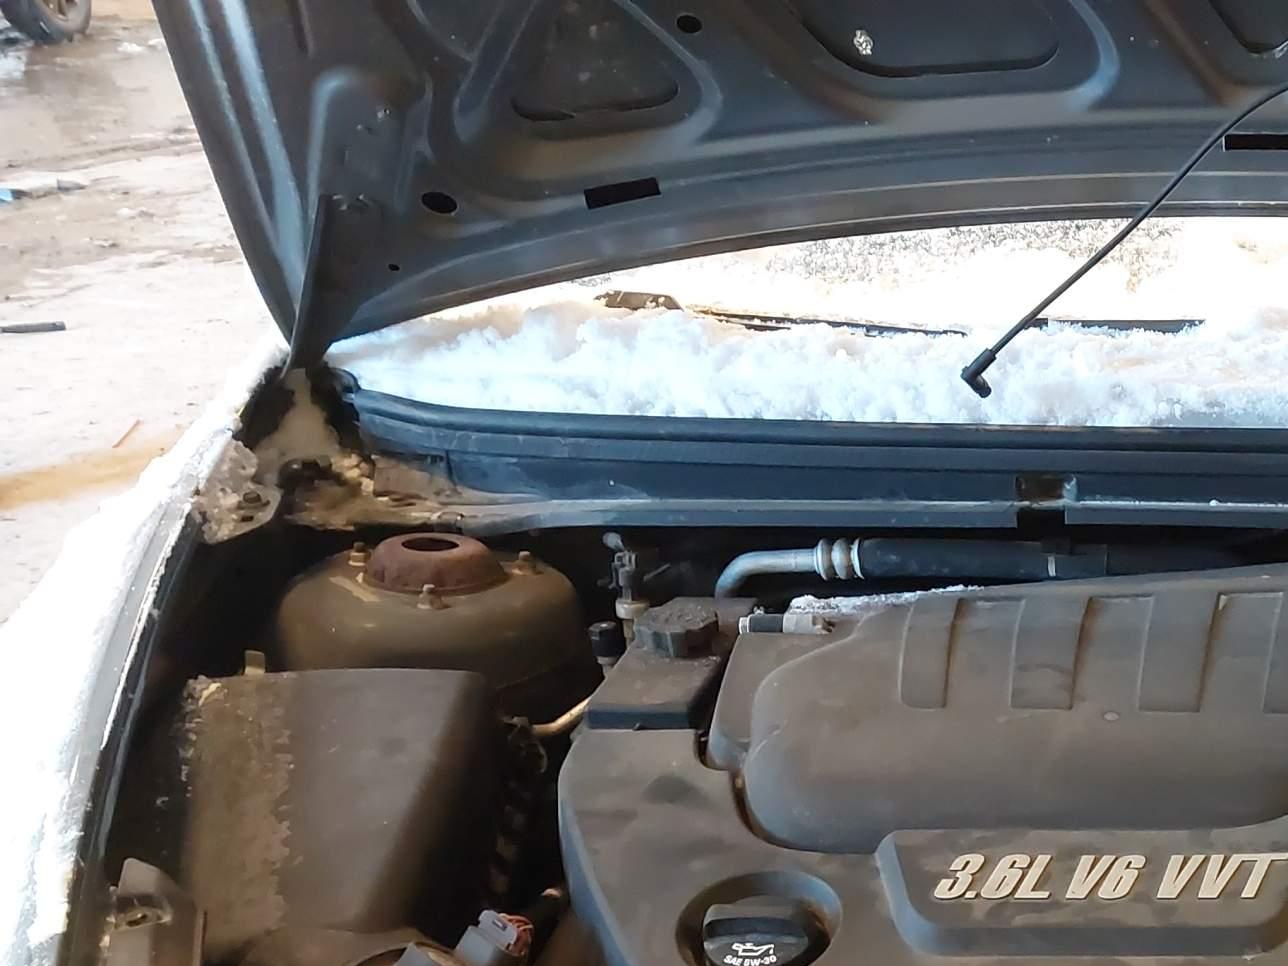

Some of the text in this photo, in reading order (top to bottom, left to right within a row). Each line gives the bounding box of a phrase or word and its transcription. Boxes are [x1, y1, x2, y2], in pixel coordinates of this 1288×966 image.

[934, 853, 1052, 900] 3.6L
[1064, 853, 1146, 900] V6
[723, 954, 743, 966] SAE
